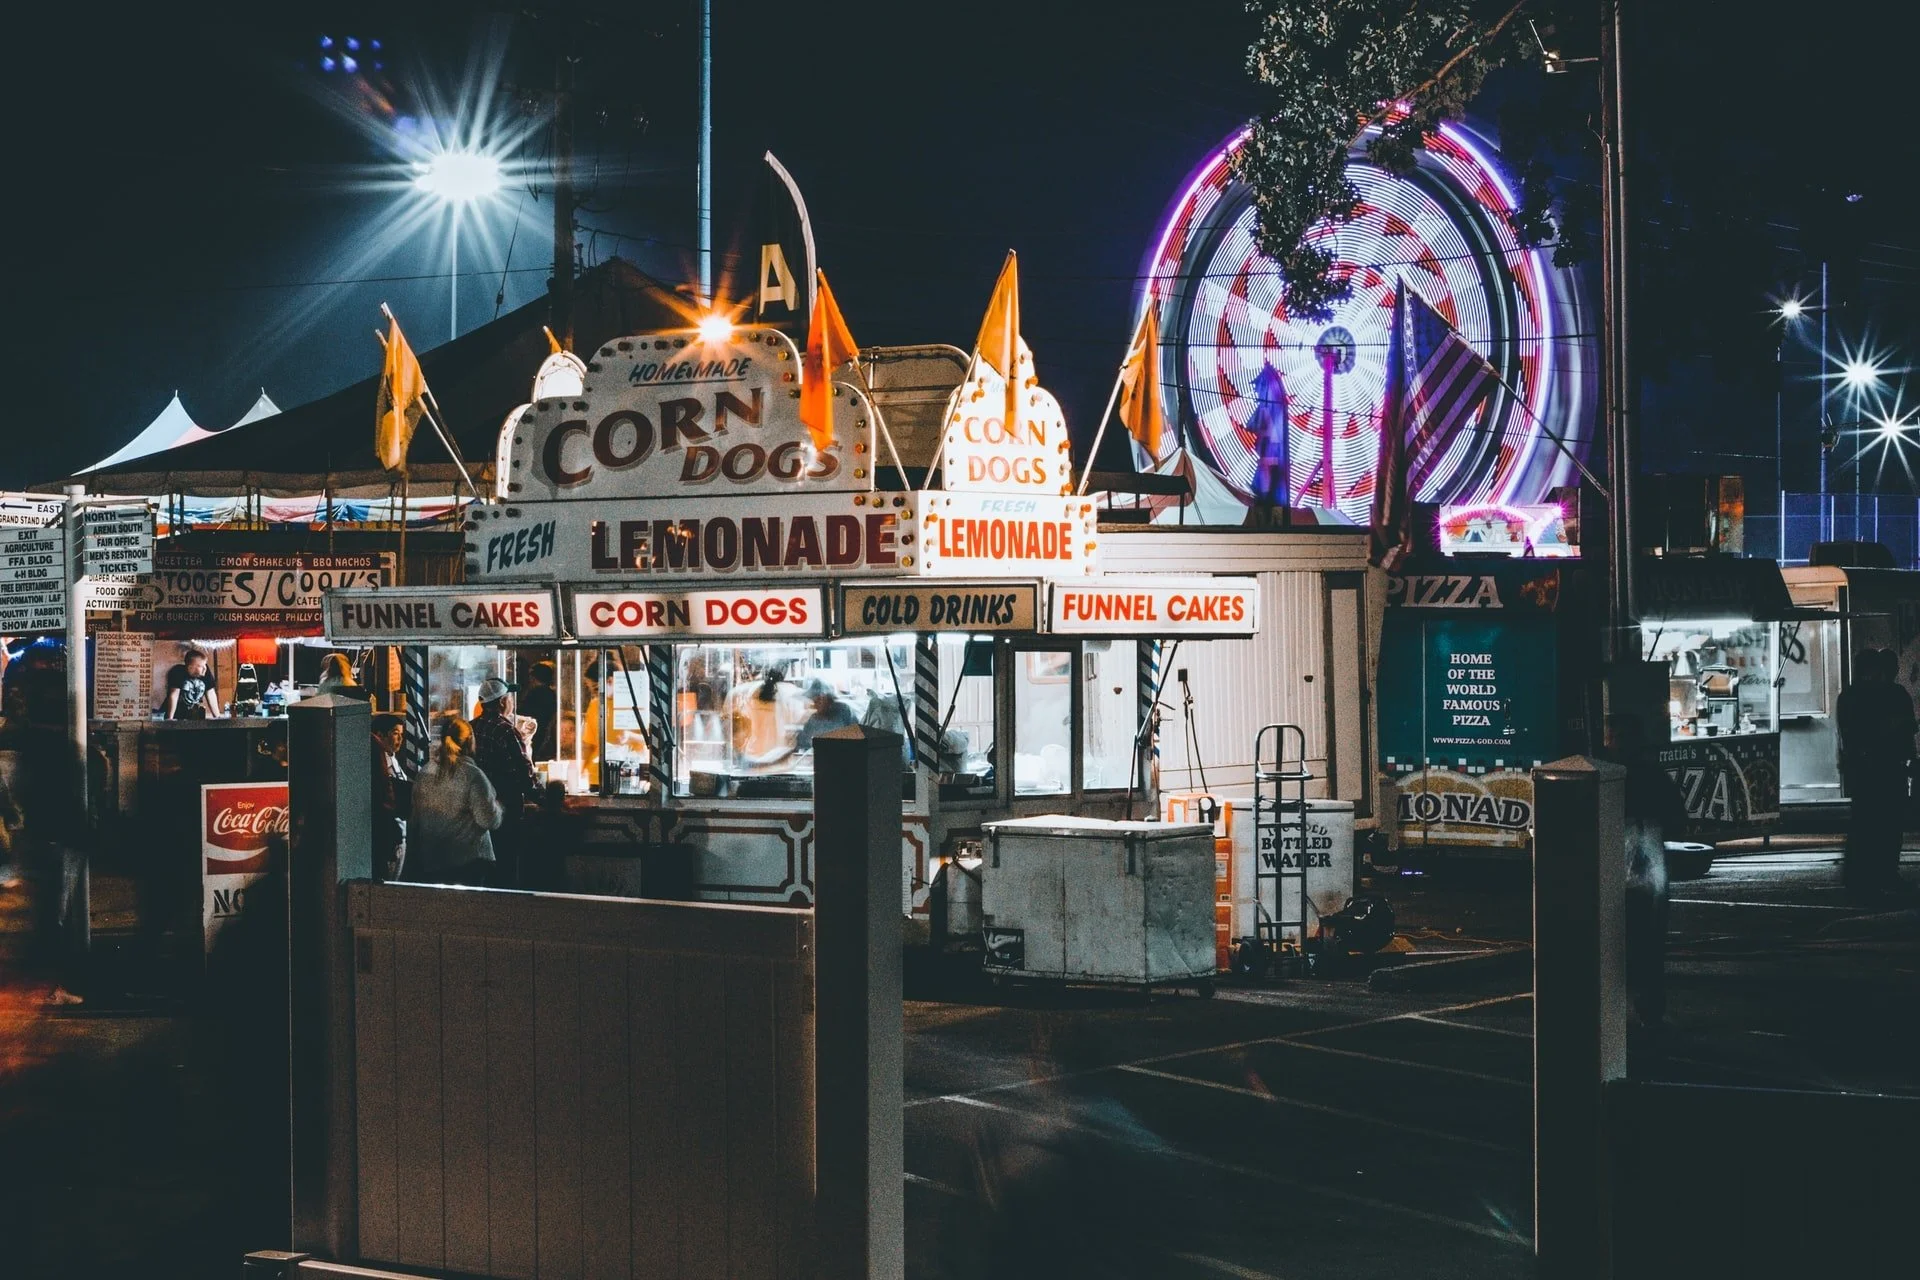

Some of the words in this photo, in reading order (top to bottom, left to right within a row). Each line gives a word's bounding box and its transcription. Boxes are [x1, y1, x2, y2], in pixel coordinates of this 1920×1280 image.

[542, 386, 765, 487] CORN
[964, 416, 1046, 446] CORN
[679, 440, 843, 484] DOGS
[968, 455, 1047, 485] DOGS
[37, 504, 61, 513] EAST
[981, 499, 1036, 513] FRESH
[0, 514, 19, 525] GRAND
[20, 515, 40, 525] STAND
[84, 511, 116, 522] NORTH
[93, 525, 117, 535] ARENA
[118, 522, 143, 533] SOUTH
[18, 530, 38, 540] EXIT
[939, 518, 1073, 560] LEMONADE
[4, 541, 54, 553] AGRICULTURE
[97, 538, 113, 547] FAIR
[114, 536, 140, 546] OFFICE
[486, 520, 556, 575] FRESH
[591, 513, 899, 573] LEMONADE
[8, 557, 25, 566] FFA
[27, 555, 53, 565] BLDG
[89, 551, 110, 561] MEN'S
[111, 548, 148, 560] RESTROOM
[99, 563, 139, 573] TICKETS
[156, 557, 181, 567] WEET
[215, 557, 250, 567] LEMON
[252, 557, 303, 568] SHAKE-UPS
[313, 557, 332, 568] BBQ
[335, 557, 371, 567] NACHOS
[14, 571, 26, 579] 4-H
[27, 568, 47, 577] BLDG
[88, 573, 109, 583] DIAPER
[110, 574, 136, 584] CHANGE
[0, 583, 15, 593] FREE
[15, 581, 60, 592] ENTERTAINMENT
[95, 587, 116, 596] FOOD
[117, 587, 144, 597] COURT
[1386, 576, 1503, 609] PIZZA
[85, 600, 131, 609] ACTIVITIES
[133, 601, 153, 610] TENT
[168, 595, 226, 605] RESTAURANT
[34, 606, 65, 617] RABBITS
[590, 600, 690, 628] CORN
[706, 597, 807, 626] DOGS
[863, 595, 919, 625] COLD
[930, 594, 1016, 626] DRINKS
[1063, 594, 1156, 621] FUNNEL
[1167, 595, 1244, 621] CAKES
[140, 612, 164, 621] PORK
[166, 613, 205, 622] BURGERS
[213, 613, 242, 622] POLISH
[244, 613, 280, 622] SAUSAGE
[285, 613, 312, 622] PHILLY
[343, 603, 441, 629] FUNNEL
[451, 602, 540, 628] CAKES
[2, 620, 29, 631] SHOW
[30, 618, 61, 629] ARENA
[1450, 653, 1493, 665] HOME
[1447, 669, 1465, 680] OF
[1468, 669, 1496, 680] THE
[1446, 684, 1497, 695] WORLD
[1443, 699, 1500, 711] FAMOUS
[1452, 715, 1491, 726] PIZZA
[1432, 737, 1511, 745] WWW.PIZZA-GOD.COM
[237, 801, 255, 810] Enjoy
[213, 806, 289, 836] Coca-Cola
[1261, 853, 1332, 868] WATER
